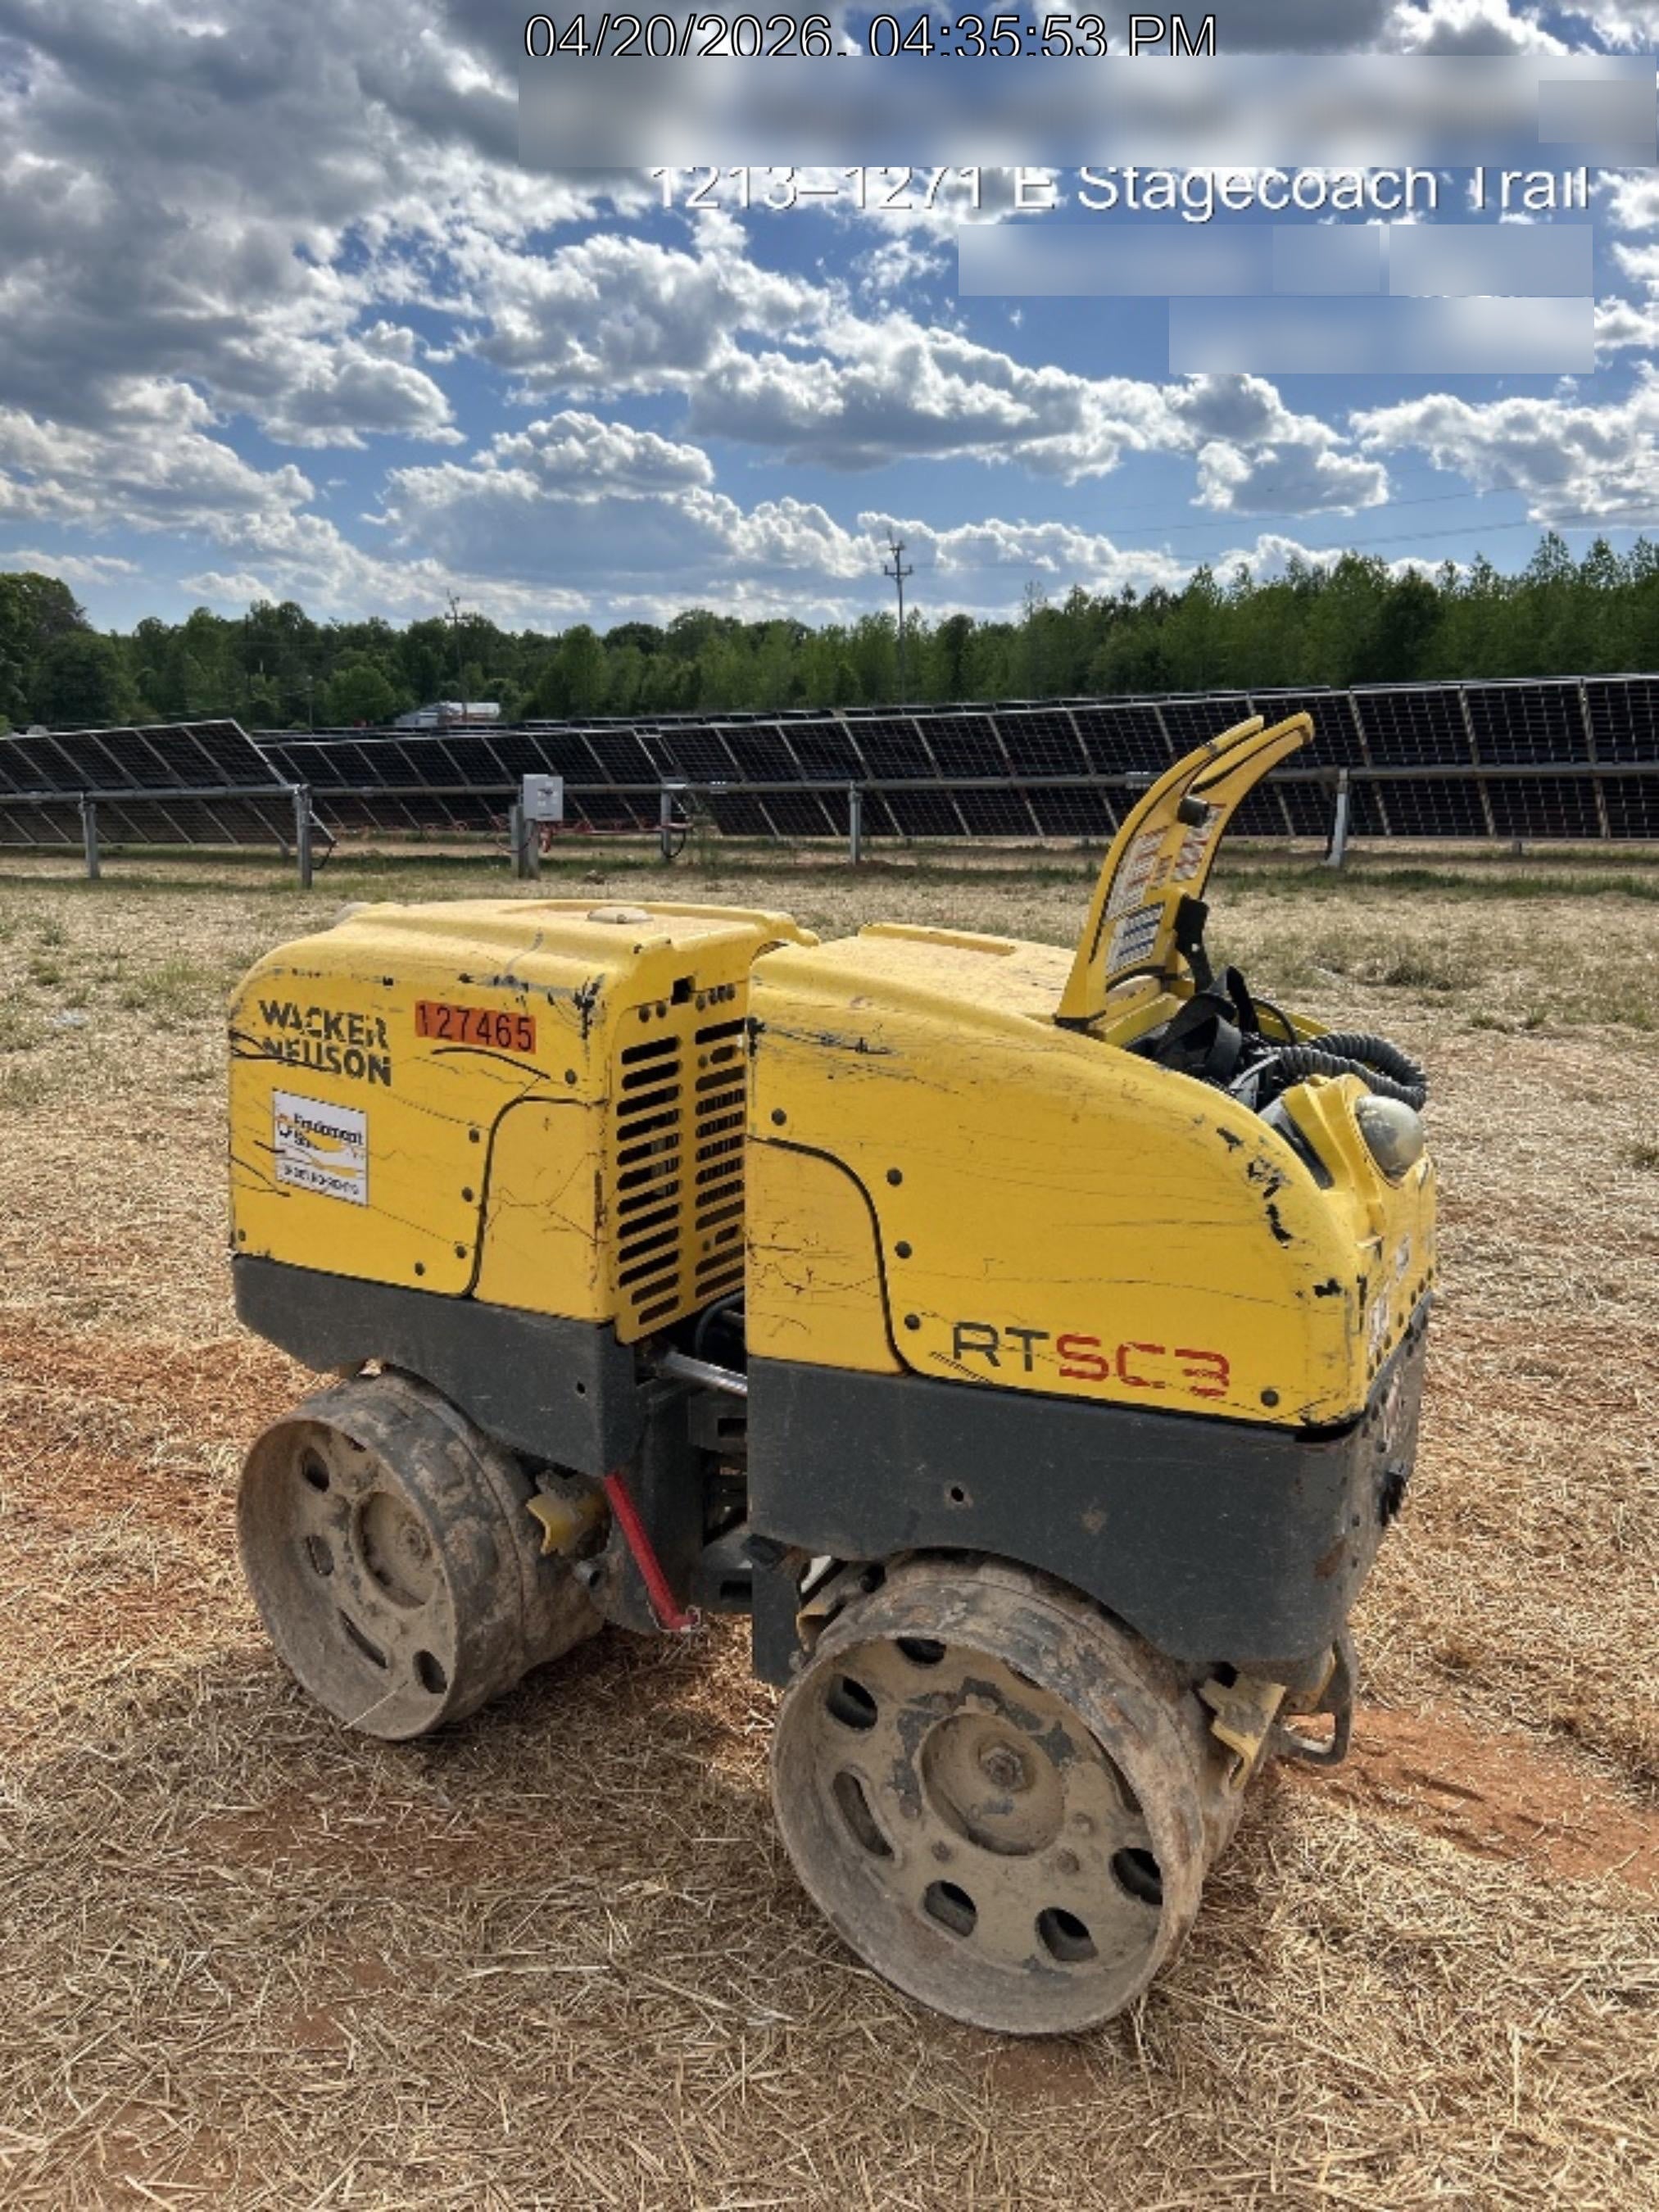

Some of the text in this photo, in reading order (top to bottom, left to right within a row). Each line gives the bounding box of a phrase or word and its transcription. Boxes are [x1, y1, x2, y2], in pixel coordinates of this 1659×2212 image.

[258, 999, 389, 1050] WACKER
[419, 1004, 533, 1050] 127465
[952, 1321, 1230, 1399] RTSC3
